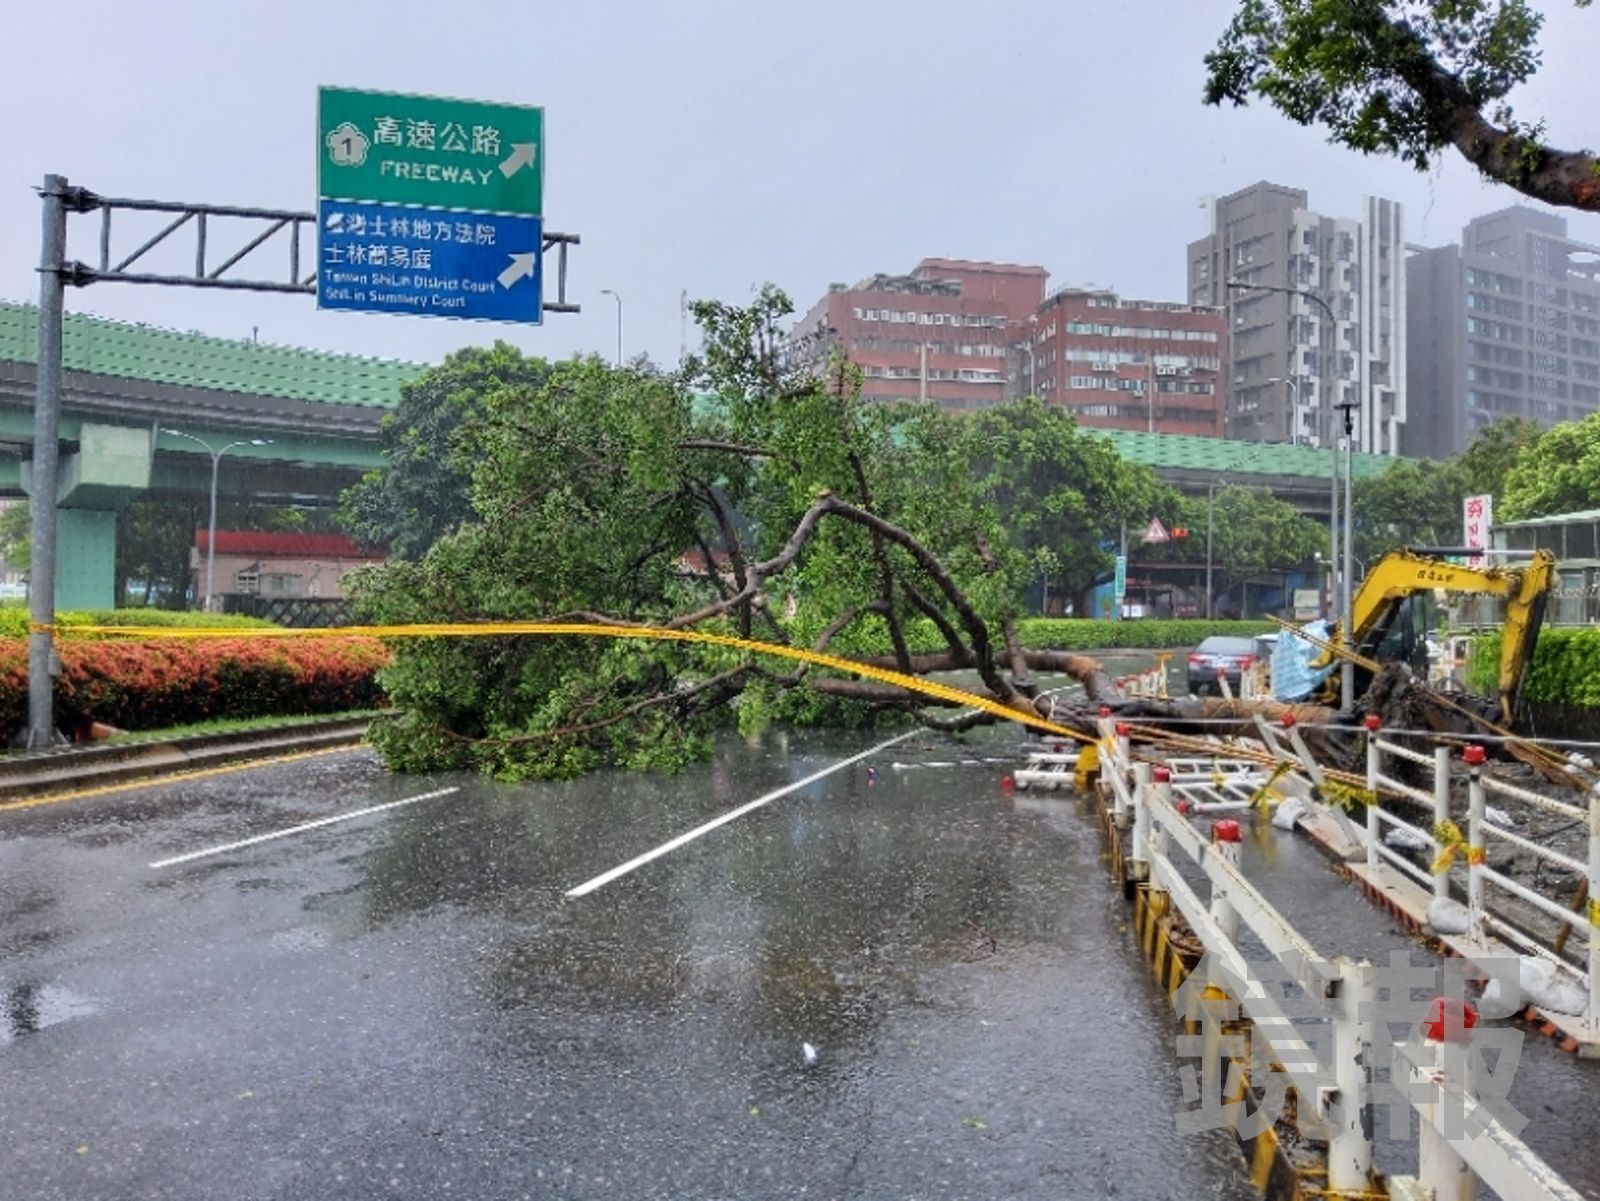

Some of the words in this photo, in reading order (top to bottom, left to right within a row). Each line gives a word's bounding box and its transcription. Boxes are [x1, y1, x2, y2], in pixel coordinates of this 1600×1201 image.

[341, 137, 352, 156] 1
[374, 115, 501, 157] 高速公路
[380, 160, 494, 185] FREEWAY
[324, 242, 432, 270] 士林簡易庭
[461, 277, 496, 294] Court
[431, 293, 467, 308] Court
